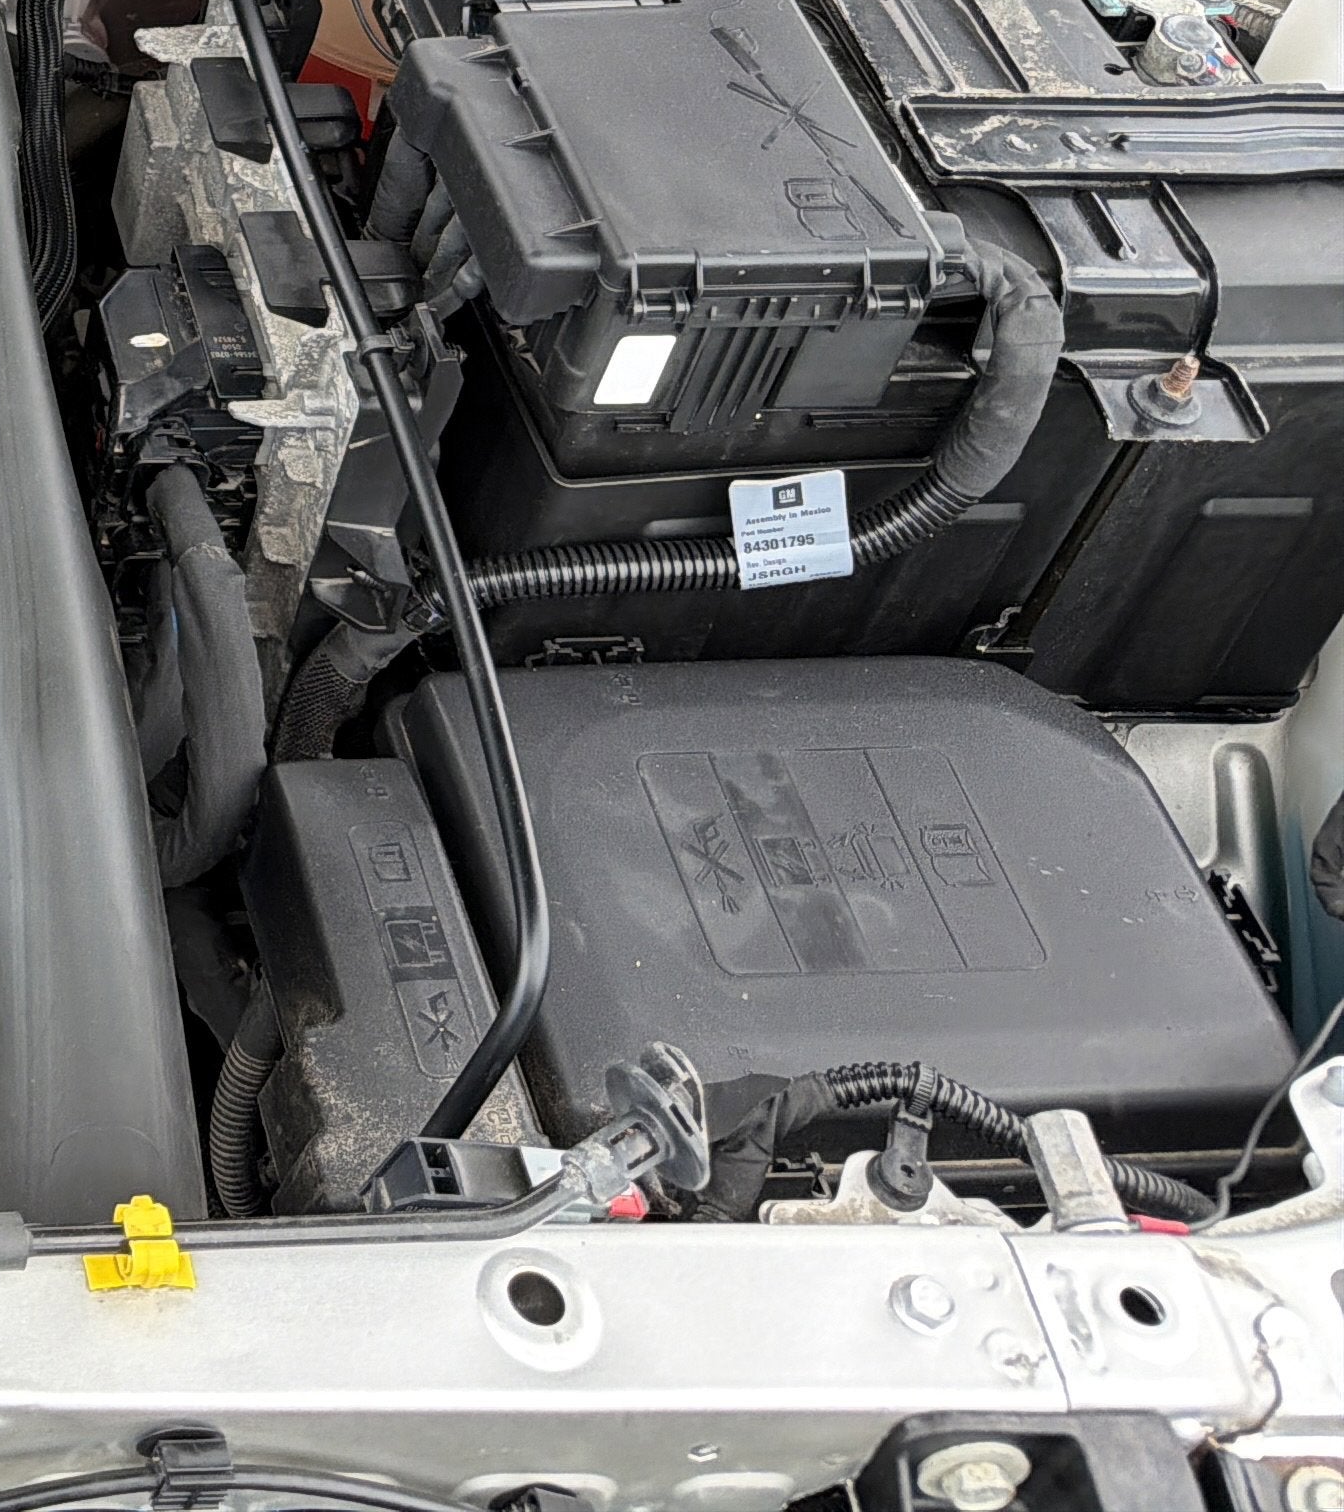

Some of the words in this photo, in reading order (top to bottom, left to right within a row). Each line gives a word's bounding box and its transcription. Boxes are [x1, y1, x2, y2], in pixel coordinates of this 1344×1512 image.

[778, 488, 796, 500] GM
[745, 513, 786, 525] Assembly
[800, 506, 832, 517] Mexico
[744, 533, 815, 554] 84301795
